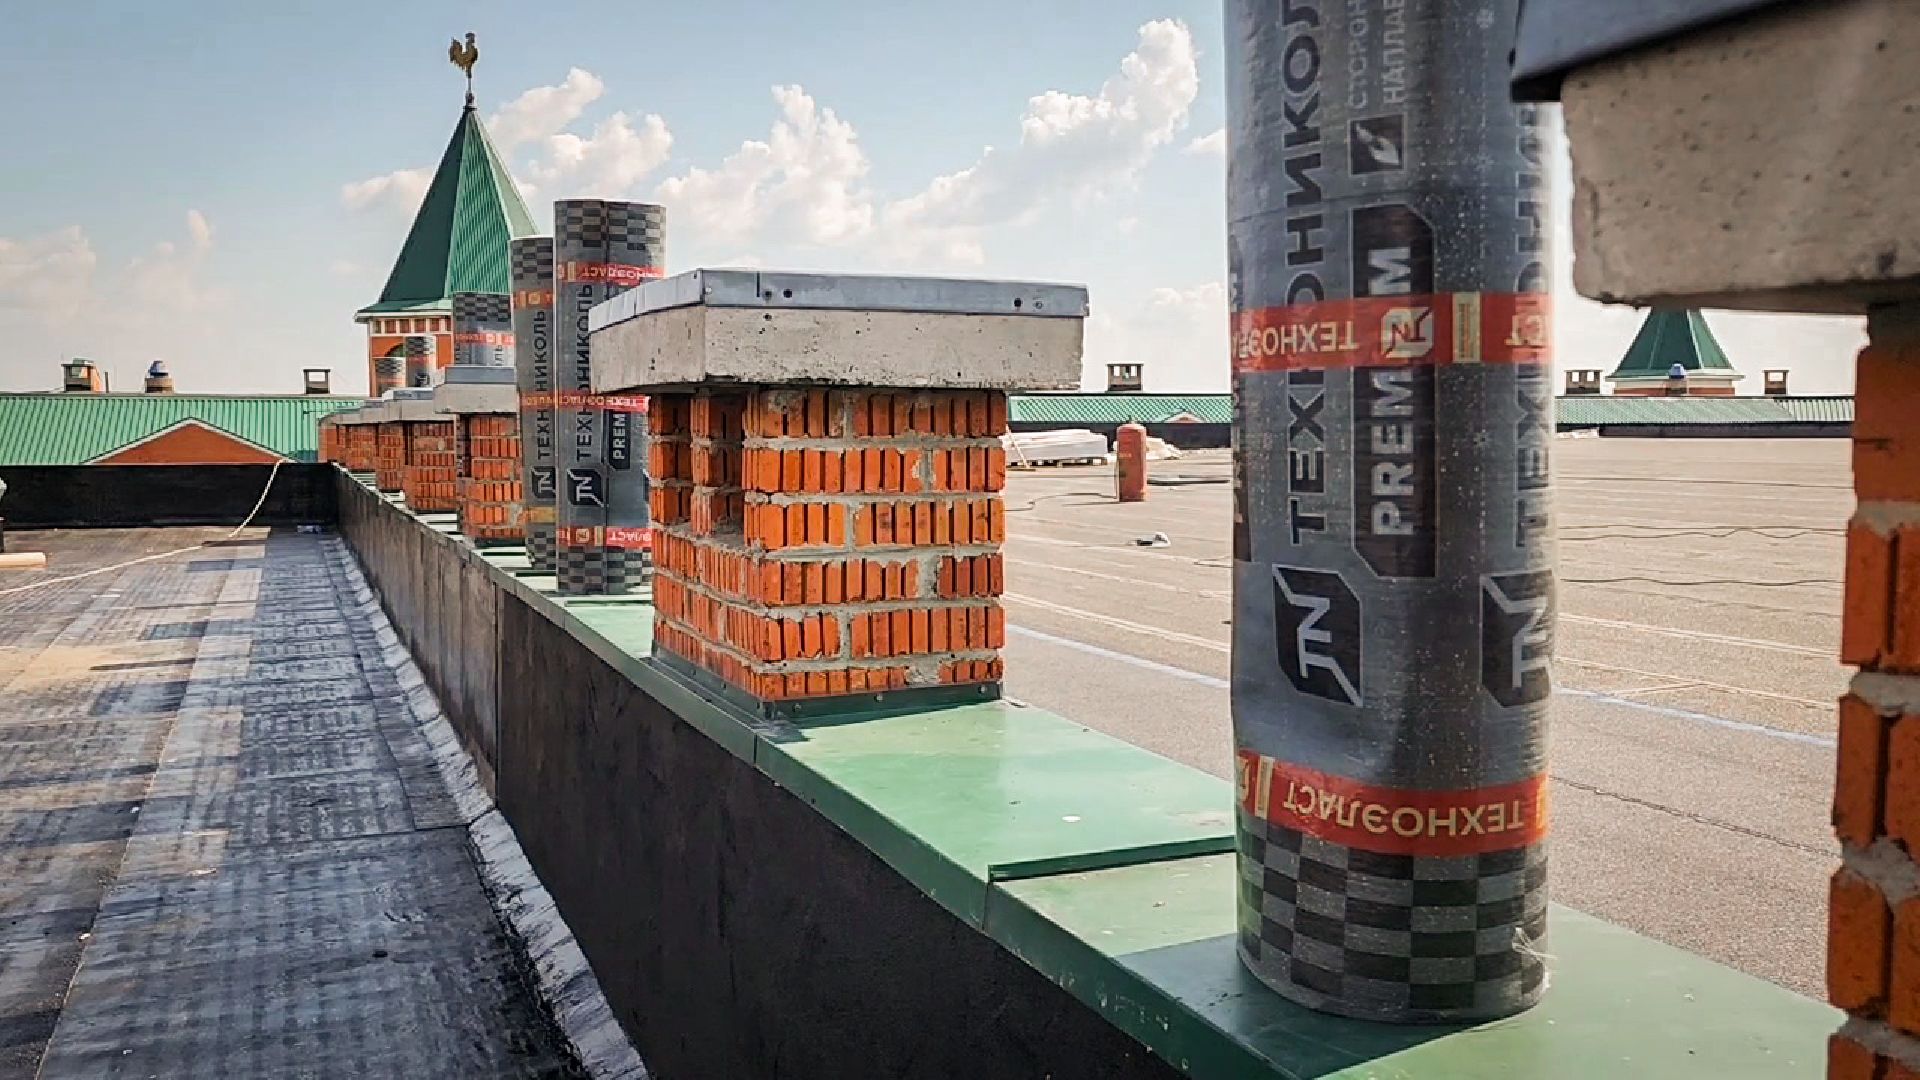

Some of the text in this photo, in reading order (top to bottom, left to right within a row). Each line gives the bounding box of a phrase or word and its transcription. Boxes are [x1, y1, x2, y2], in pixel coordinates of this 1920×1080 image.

[1348, 0, 1368, 110] СТОРОН
[1282, 0, 1328, 546] ТЕХОНИКОЛ
[533, 311, 551, 460] ТЕХННИКОЛЬ
[612, 413, 626, 461] PREM
[1366, 246, 1415, 536] PREMM
[1281, 781, 1526, 838] ТЕХНОЭЛАСТ
